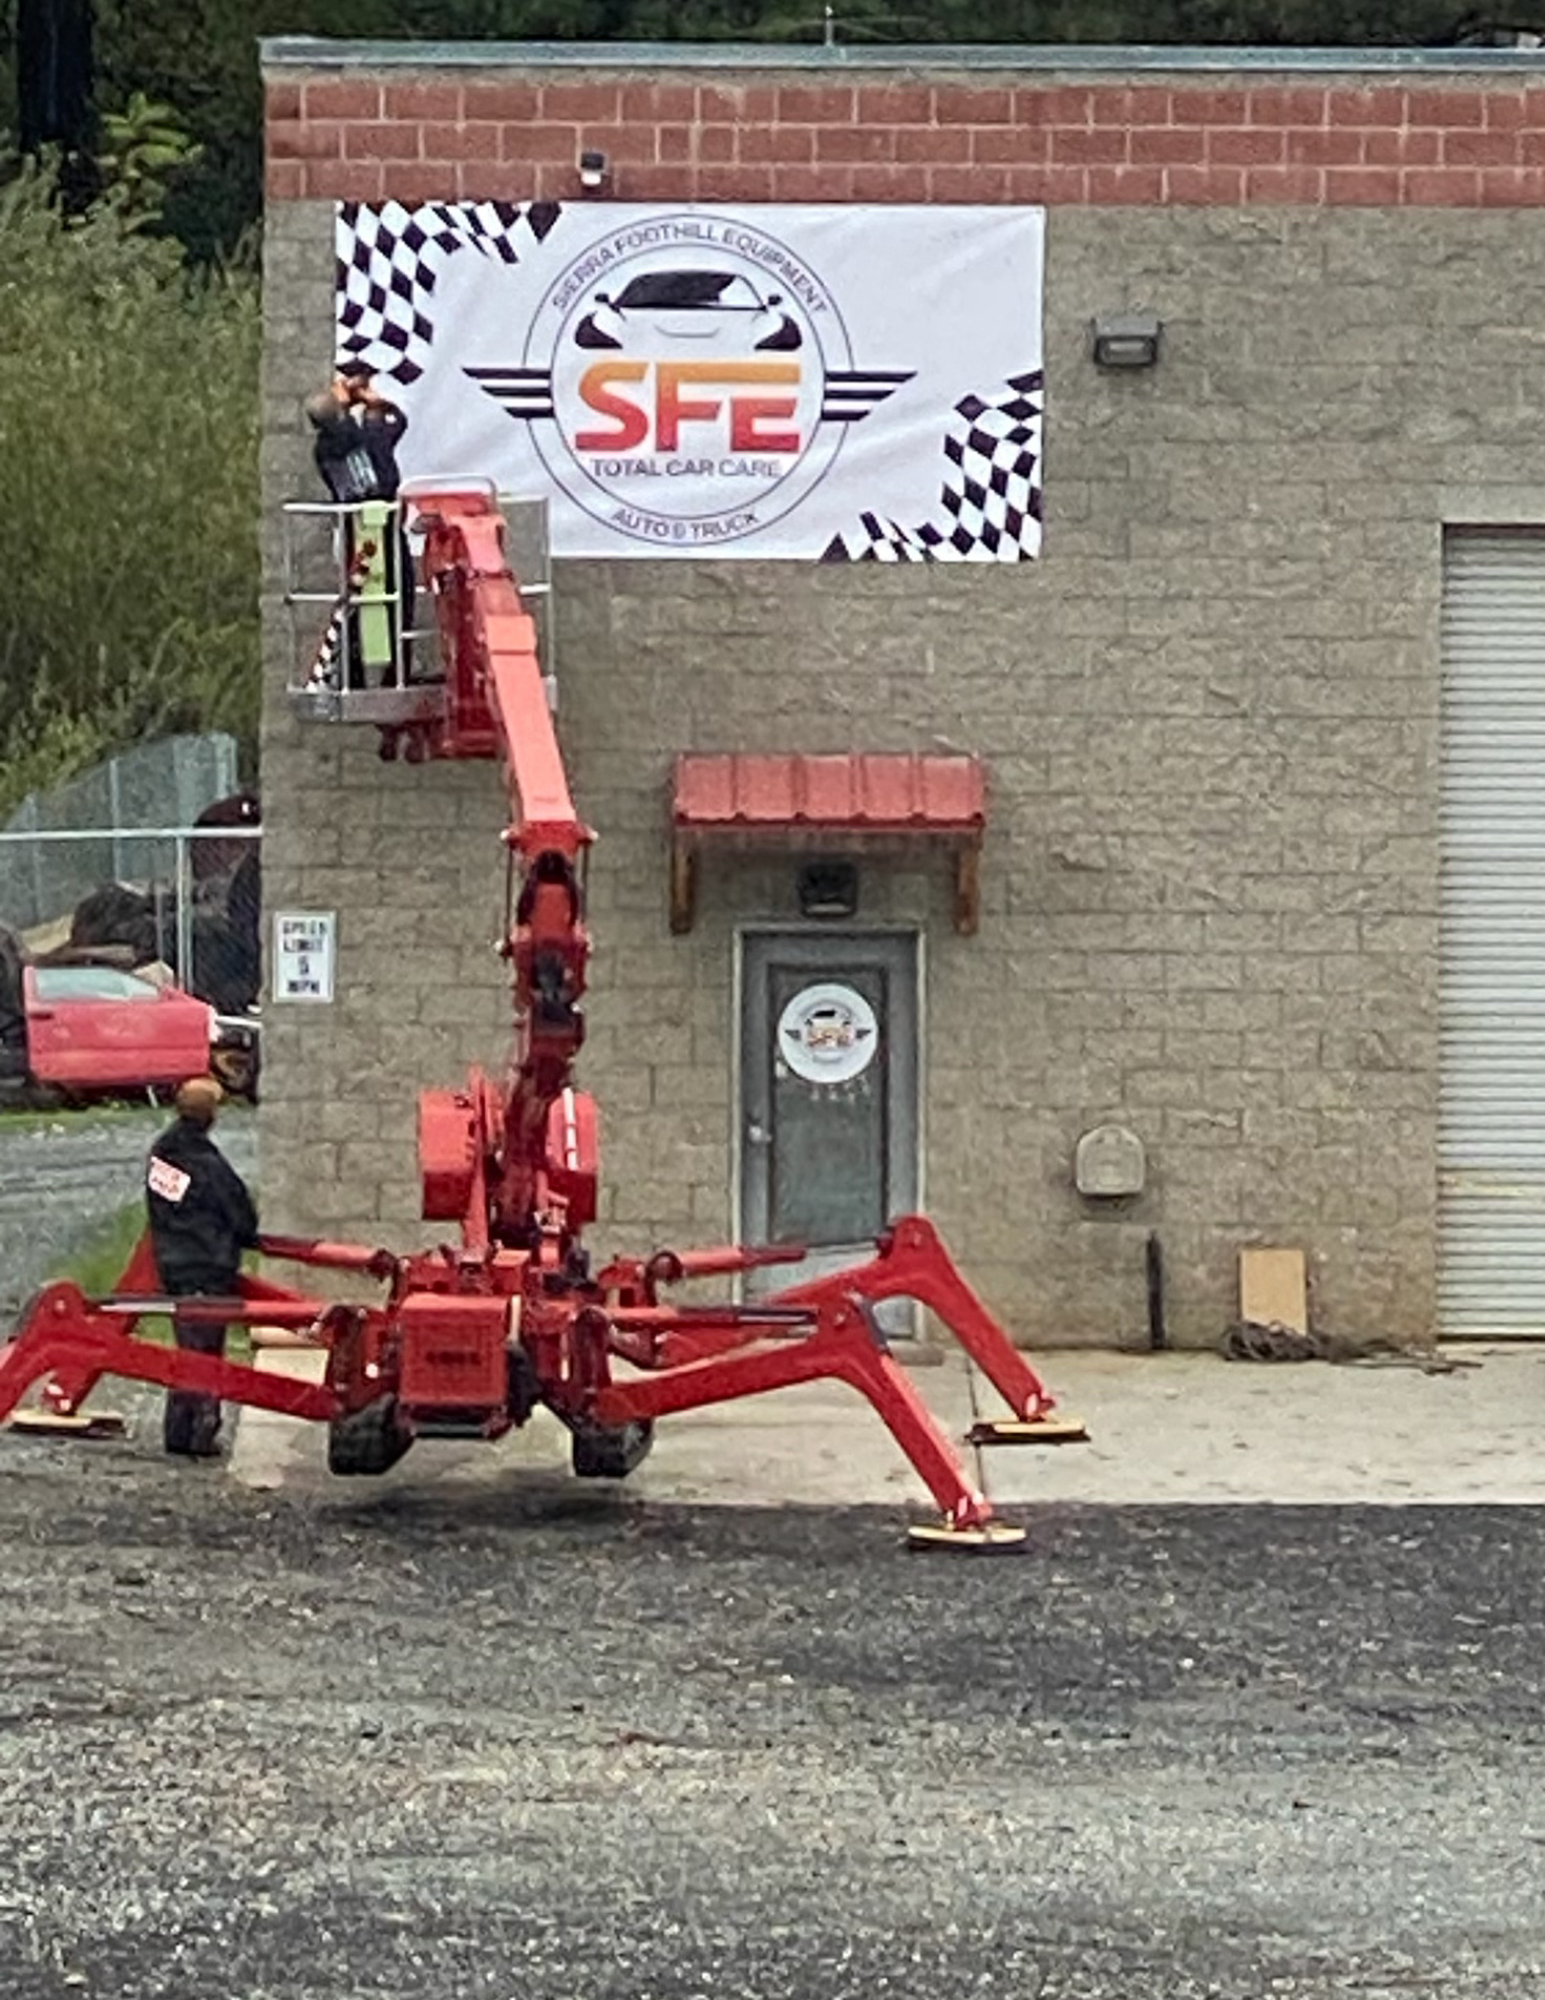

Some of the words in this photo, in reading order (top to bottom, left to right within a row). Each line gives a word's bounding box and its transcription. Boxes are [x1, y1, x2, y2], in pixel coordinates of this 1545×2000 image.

[554, 250, 614, 310] SIERRA
[617, 224, 717, 255] FOOTHILL
[724, 228, 827, 312] EQUIPMENT
[574, 361, 801, 453] SFE
[592, 457, 662, 477] TOTAL
[666, 457, 714, 477] CAR
[719, 458, 781, 478] CARE
[612, 508, 669, 537] AUTO
[691, 513, 759, 539] TRUCK
